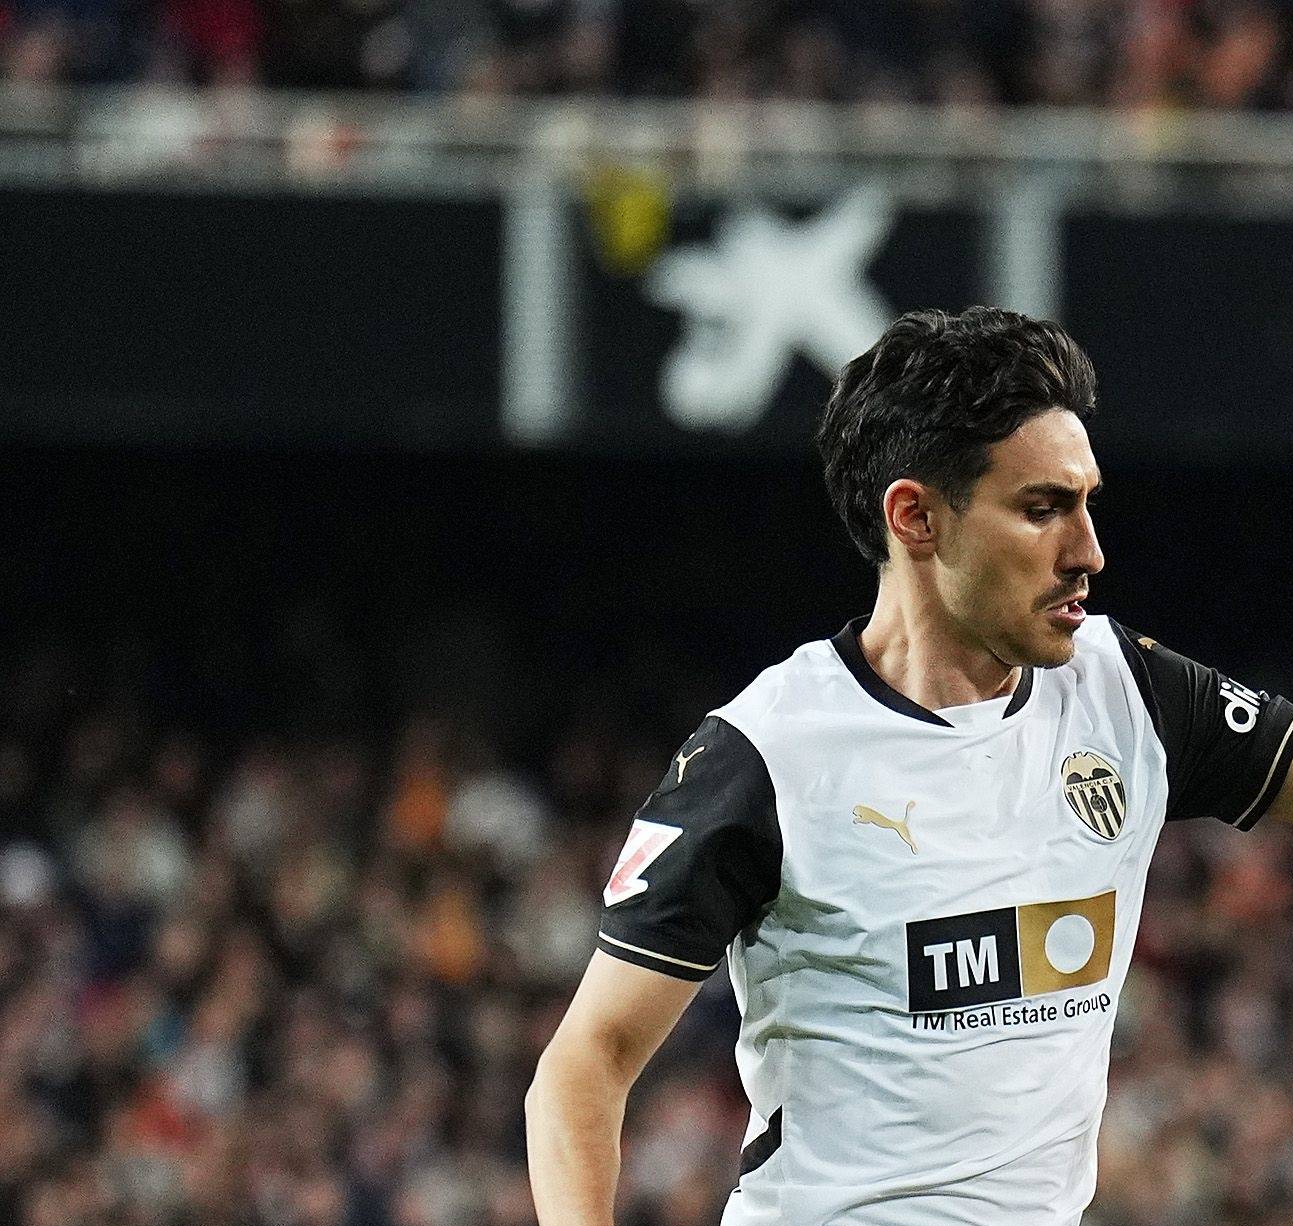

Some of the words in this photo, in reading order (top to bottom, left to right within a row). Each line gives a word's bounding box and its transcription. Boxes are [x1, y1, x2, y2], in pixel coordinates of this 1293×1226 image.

[923, 935, 1000, 992] TM
[954, 1006, 997, 1031] Real
[1002, 1005, 1058, 1026] Estate
[1064, 992, 1111, 1019] Group
